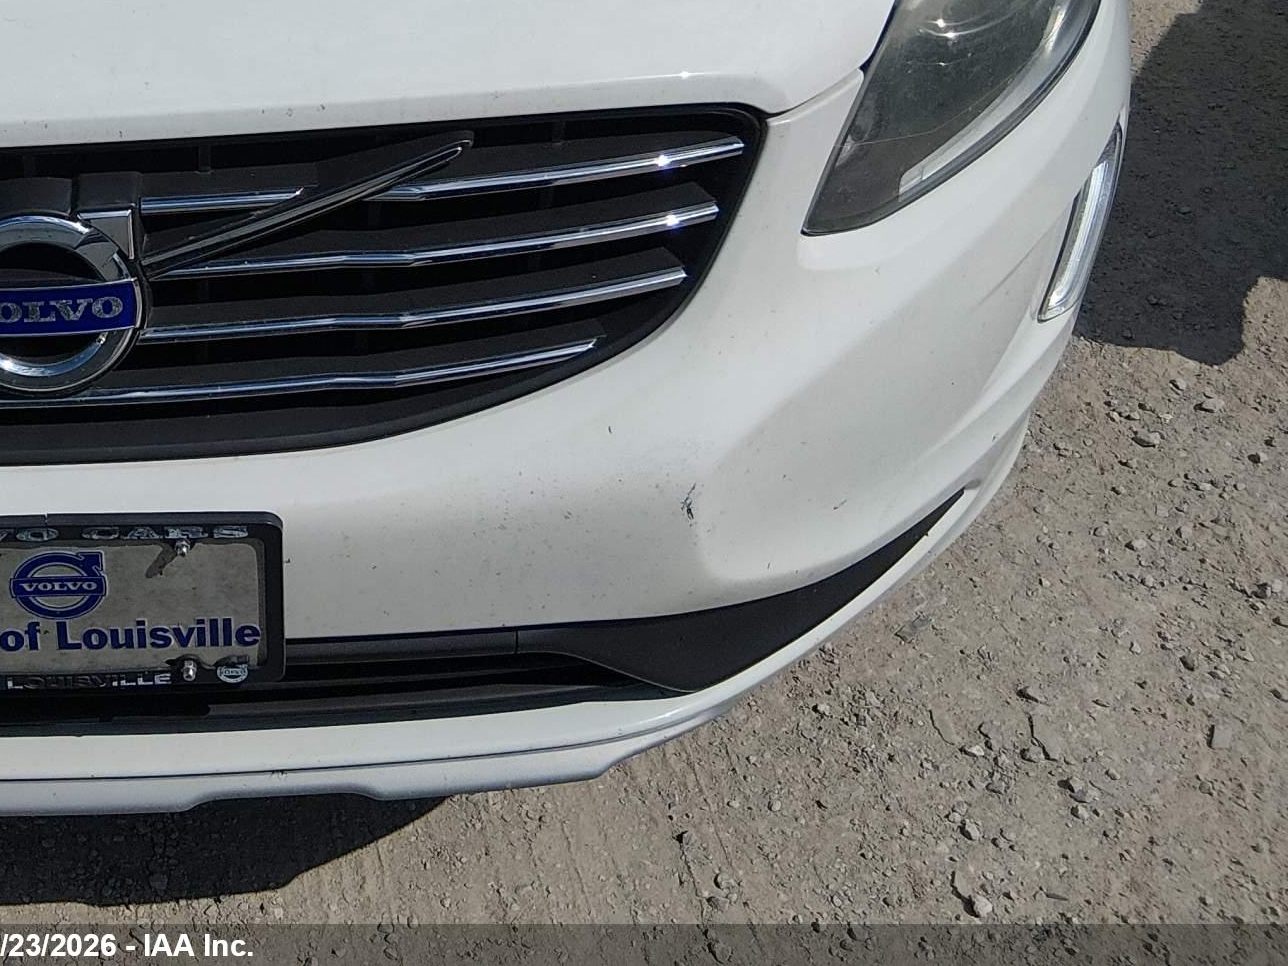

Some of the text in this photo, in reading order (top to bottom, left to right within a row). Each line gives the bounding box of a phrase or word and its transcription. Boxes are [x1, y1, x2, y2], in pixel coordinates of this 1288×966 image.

[19, 581, 98, 592] VOLVO
[0, 620, 42, 651] of
[56, 617, 262, 650] Louisville
